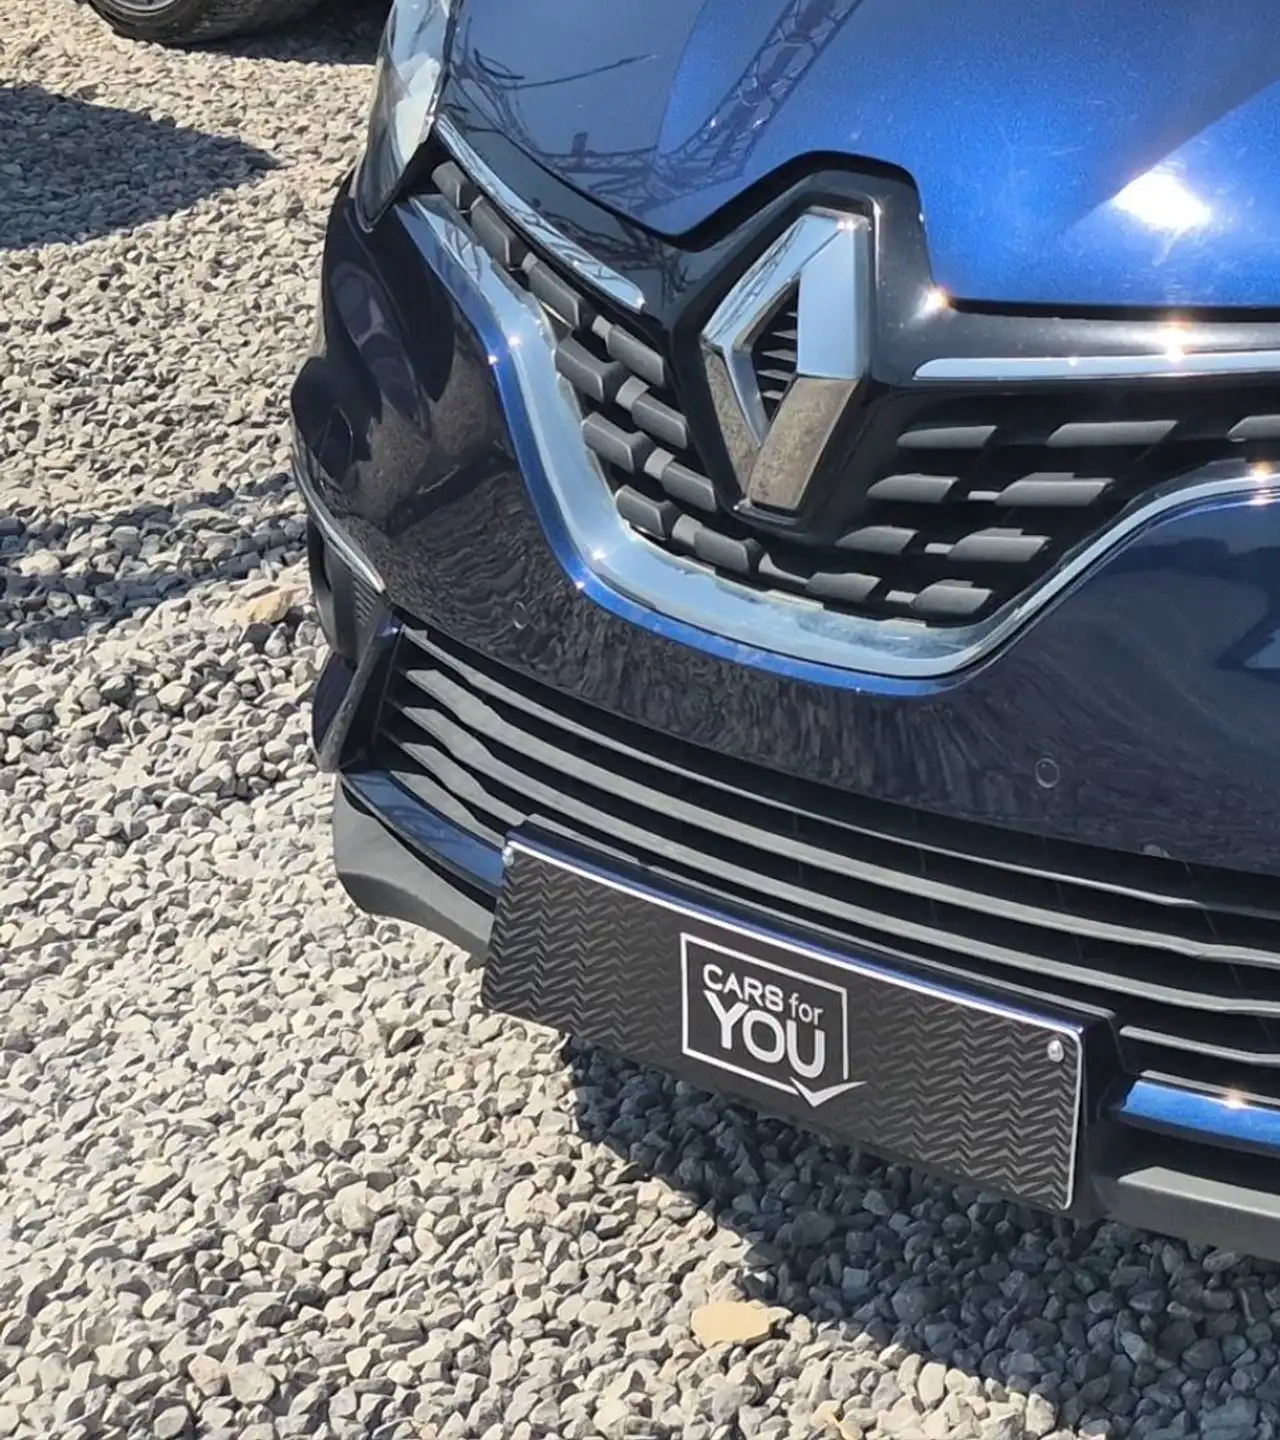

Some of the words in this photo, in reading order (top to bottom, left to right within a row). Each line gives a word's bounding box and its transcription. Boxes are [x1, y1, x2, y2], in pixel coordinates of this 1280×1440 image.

[702, 963, 784, 1013] CARS
[788, 992, 825, 1026] for
[702, 990, 826, 1079] YOU
